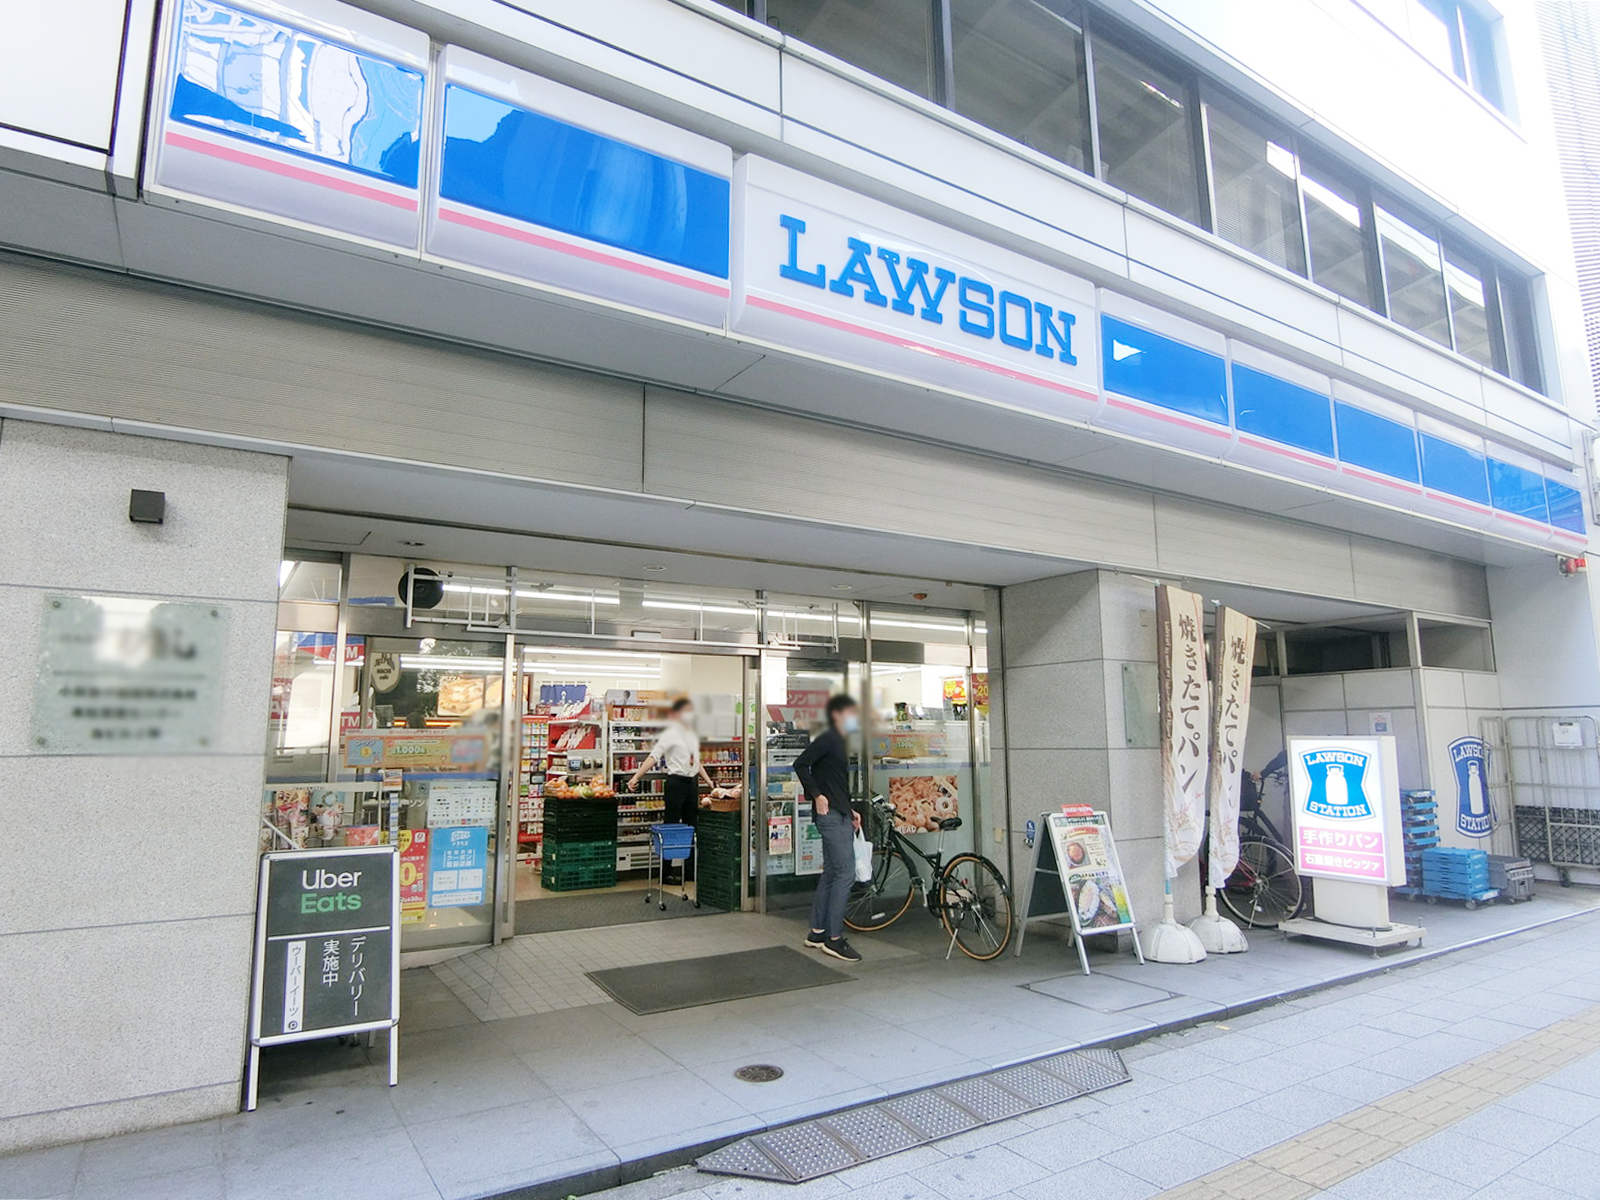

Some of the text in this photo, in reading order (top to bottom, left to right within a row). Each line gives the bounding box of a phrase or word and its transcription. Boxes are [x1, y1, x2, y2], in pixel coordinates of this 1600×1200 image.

[779, 213, 1078, 367] LAWSON
[327, 646, 358, 661] AM
[1177, 613, 1202, 794] 焼きたてパン
[793, 709, 818, 720] ATM
[1304, 752, 1365, 767] LAWSON
[1309, 801, 1368, 817] STATION
[1460, 813, 1491, 831] STATIO
[1303, 829, 1379, 849] 手作りパン
[302, 869, 362, 890] Uber
[301, 892, 362, 914] Eats
[322, 939, 340, 987] 実施中
[289, 946, 302, 1017] ウーバーイーツ
[349, 935, 368, 1016] デリバリー
